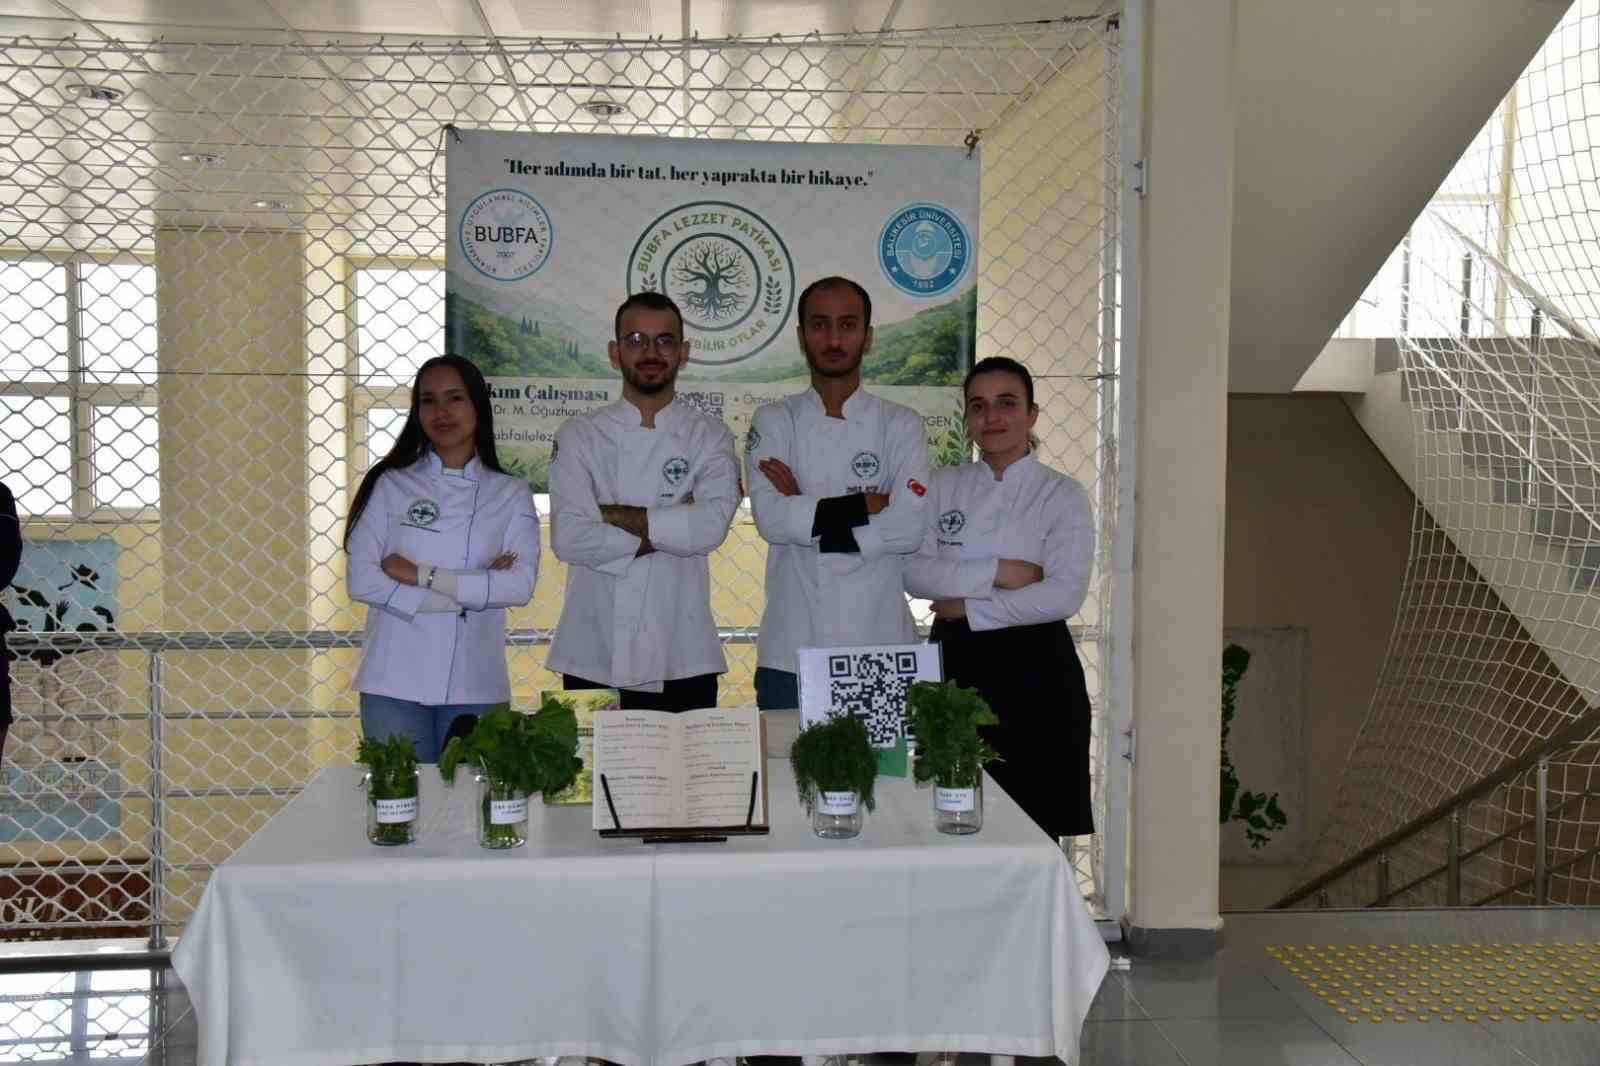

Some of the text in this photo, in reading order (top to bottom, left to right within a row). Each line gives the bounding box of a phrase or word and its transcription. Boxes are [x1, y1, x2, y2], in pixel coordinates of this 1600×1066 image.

[503, 159, 542, 175] "Her
[544, 161, 606, 179] adımda
[610, 163, 635, 179] bir
[670, 165, 699, 181] her
[701, 168, 777, 187] yaprakta
[781, 169, 806, 185] bir
[809, 169, 874, 190] hikaye."
[475, 226, 538, 243] BUBFA
[638, 212, 784, 273] BUBFA LEZZET PATİKASI
[728, 319, 767, 346] OTLAR
[488, 383, 609, 405] kım Çalışması
